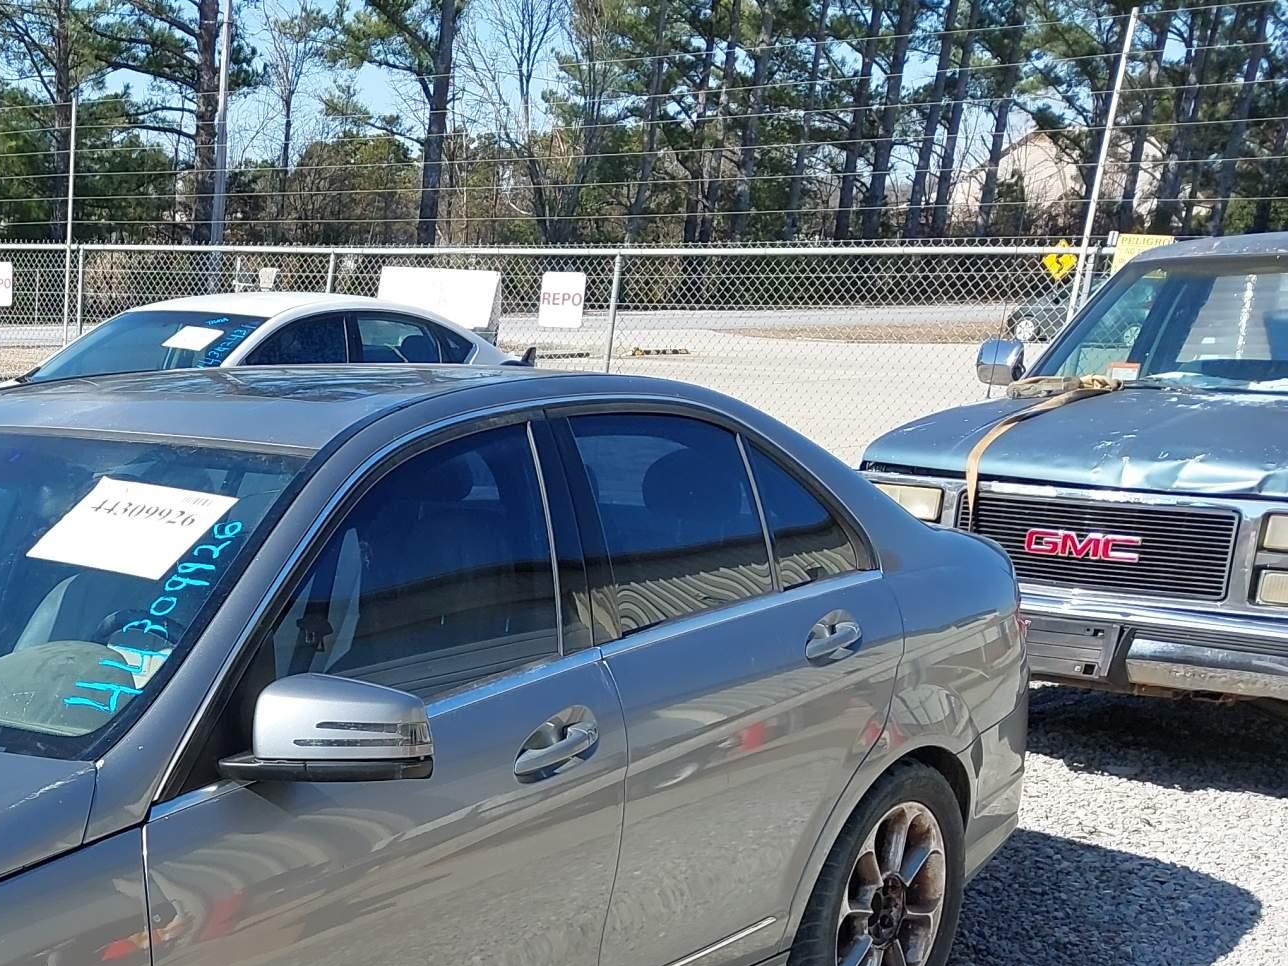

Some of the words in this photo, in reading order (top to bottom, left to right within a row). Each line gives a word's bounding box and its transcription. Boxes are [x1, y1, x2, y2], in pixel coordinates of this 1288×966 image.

[541, 291, 583, 306] REPO
[91, 499, 196, 527] 44309926
[1024, 528, 1141, 563] GMC
[63, 520, 243, 714] 44309926
